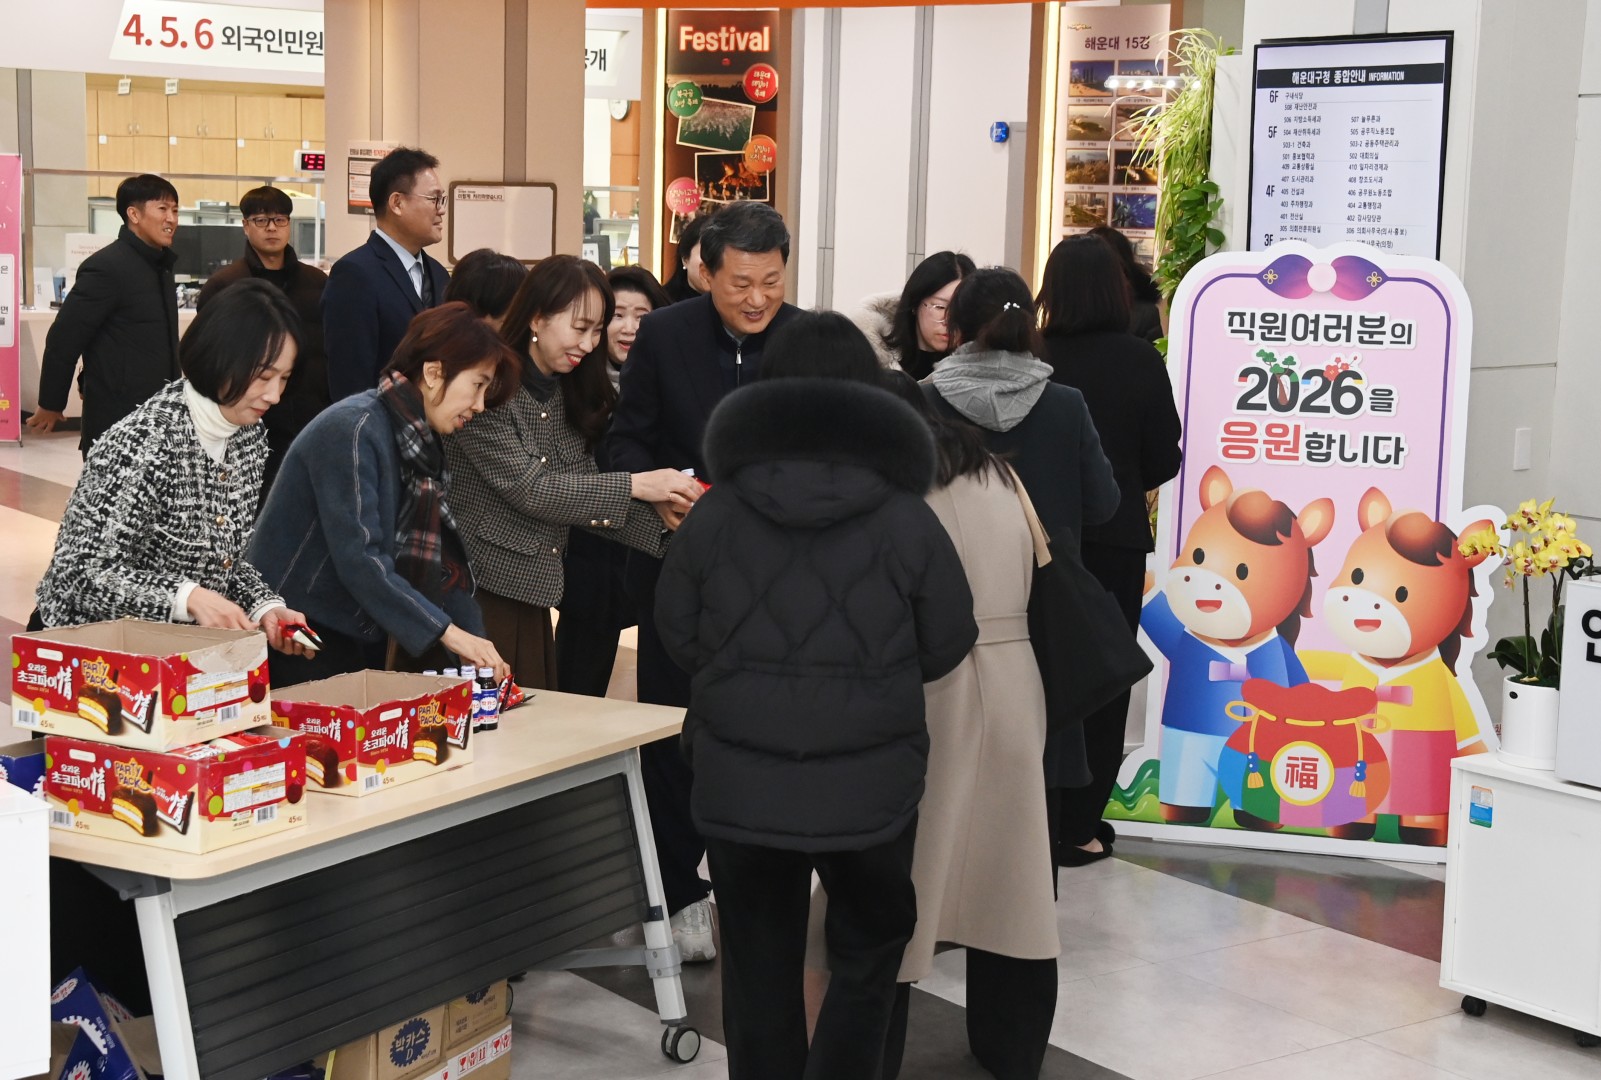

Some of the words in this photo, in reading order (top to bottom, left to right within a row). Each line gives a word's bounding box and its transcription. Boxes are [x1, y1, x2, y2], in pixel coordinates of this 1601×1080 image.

[221, 25, 324, 56] 외국인민원
[679, 26, 769, 51] Festival
[1084, 35, 1120, 50] 해운대
[1291, 71, 1331, 85] 해운대구청
[1333, 69, 1366, 84] 종합안내
[1368, 71, 1405, 82] INFORMATION
[1269, 90, 1279, 103] 6F
[1268, 126, 1278, 139] 5F
[1265, 184, 1276, 198] 4F
[1264, 233, 1275, 247] 3F
[1228, 311, 1412, 345] 직원여러분의
[1220, 421, 1405, 465] 응원합니다
[27, 662, 48, 674] 오리온
[82, 658, 110, 677] PARTY
[17, 670, 58, 690] 초코파이
[57, 665, 73, 700] 情
[84, 670, 108, 688] PACK
[419, 701, 439, 714] PARTY
[420, 715, 438, 726] PACK
[299, 723, 329, 736] 초코파이
[371, 726, 388, 738] 오리온
[363, 732, 396, 752] 초코파이
[60, 763, 81, 775] 오리온
[115, 761, 142, 778] PARTY
[1285, 756, 1319, 790] 福
[52, 771, 91, 790] 초코파이
[90, 766, 106, 802] 情
[118, 773, 140, 788] PACK
[395, 1028, 426, 1051] 박카스
[405, 1048, 414, 1061] D
